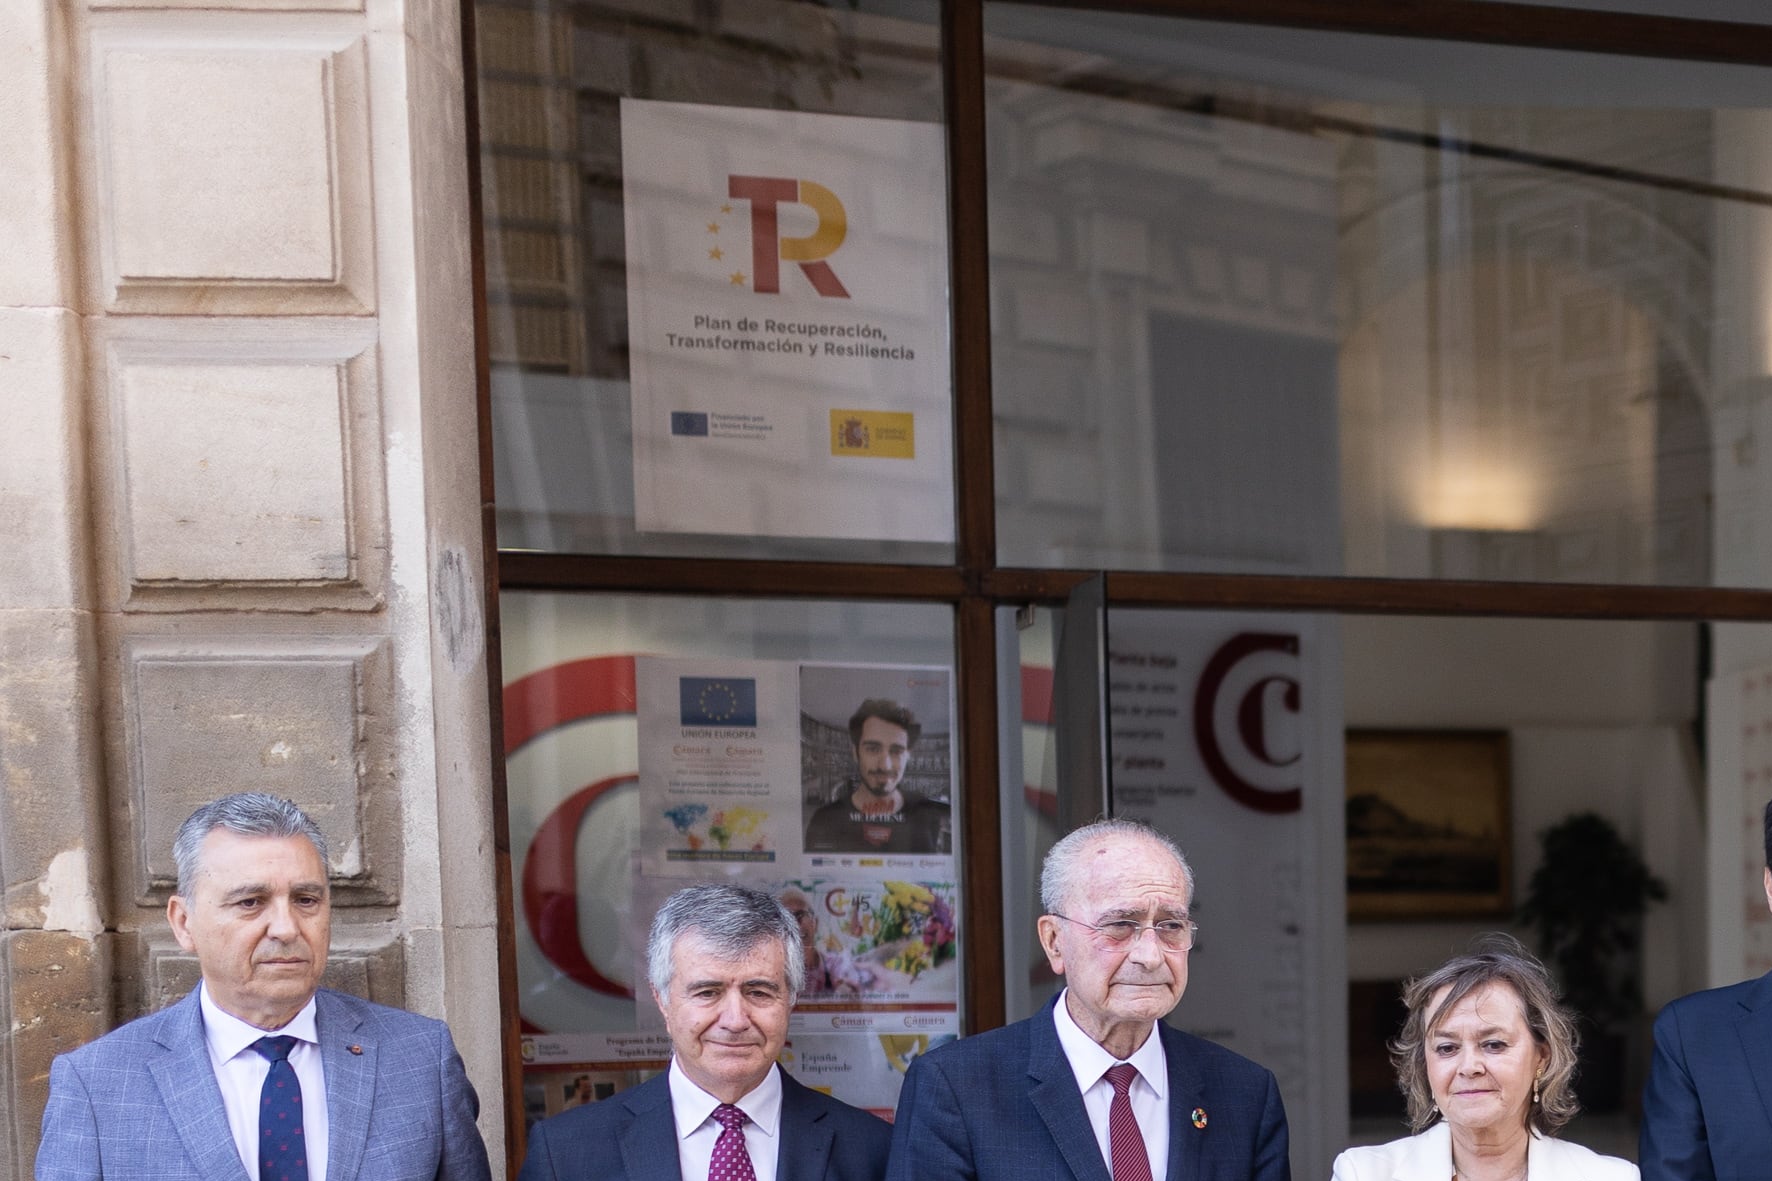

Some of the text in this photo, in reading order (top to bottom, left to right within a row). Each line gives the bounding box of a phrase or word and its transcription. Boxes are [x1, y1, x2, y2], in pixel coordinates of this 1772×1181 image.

[694, 315, 887, 341] Plan de Recuperación,
[666, 333, 915, 361] Transformación y Resiliencia
[714, 730, 756, 739] EUROPEA
[832, 1016, 873, 1028] Cámara
[904, 1015, 945, 1028] Cámara
[606, 1037, 643, 1046] Programa
[644, 1036, 654, 1044] de
[801, 1052, 837, 1063] España
[801, 1063, 852, 1074] Emprende
